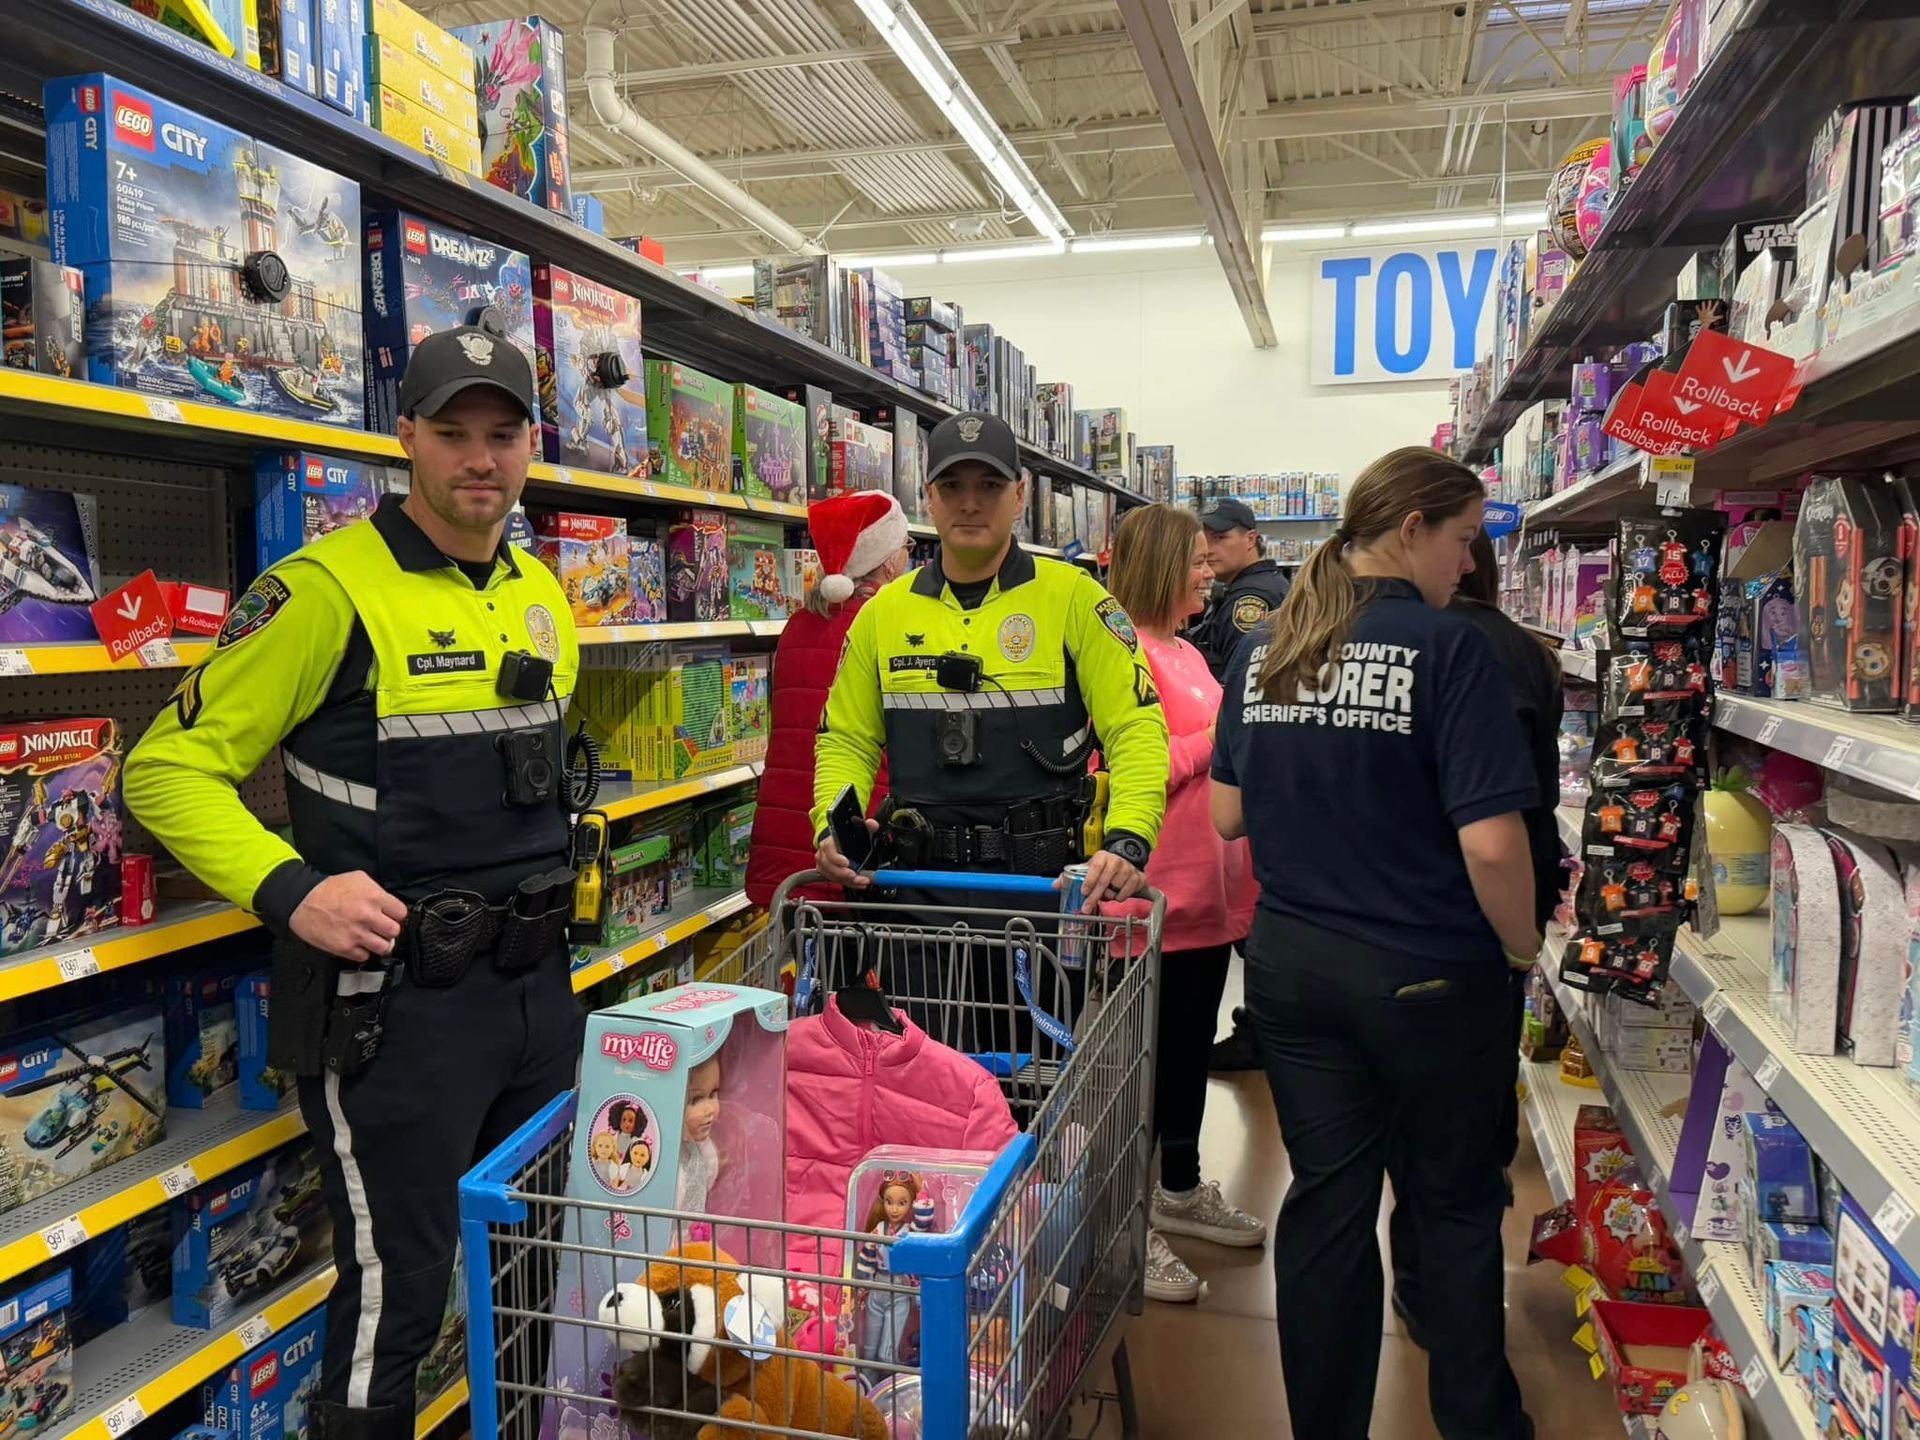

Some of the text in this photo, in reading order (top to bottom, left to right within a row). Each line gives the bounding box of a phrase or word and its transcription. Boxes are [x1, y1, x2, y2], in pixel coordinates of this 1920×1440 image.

[84, 117, 98, 151] CITY
[116, 107, 208, 161] LEGO CITY
[115, 160, 138, 181] 7+
[116, 184, 144, 199] 60419
[406, 229, 426, 245] LEGO
[571, 279, 619, 319] NINJAGO
[1322, 248, 1510, 376] TOY
[1680, 376, 1763, 420] Rollback
[1638, 411, 1713, 446] Rollback
[287, 472, 297, 493] CITY
[326, 467, 348, 485] CITY
[305, 496, 318, 508] 6+
[1666, 549, 1681, 561] 15
[1669, 597, 1680, 609] 18
[188, 617, 220, 630] Rollback
[111, 616, 168, 658] Rollback
[416, 653, 476, 671] Cpl. Maynard
[914, 656, 937, 668] Ayers
[1341, 642, 1420, 667] OUNTY
[1664, 673, 1675, 686] 18
[1242, 704, 1412, 735] SHERIFF'S OFFICE
[0, 728, 98, 759] EGO NINJAGO
[1650, 747, 1661, 761] 18
[1636, 820, 1646, 833] 18
[1030, 1008, 1064, 1039] Walmart
[22, 1047, 49, 1069] CITY
[658, 1058, 669, 1067] as
[230, 1179, 252, 1200] CITY
[251, 1329, 317, 1389] LEGO CITY
[250, 1400, 268, 1419] 6+
